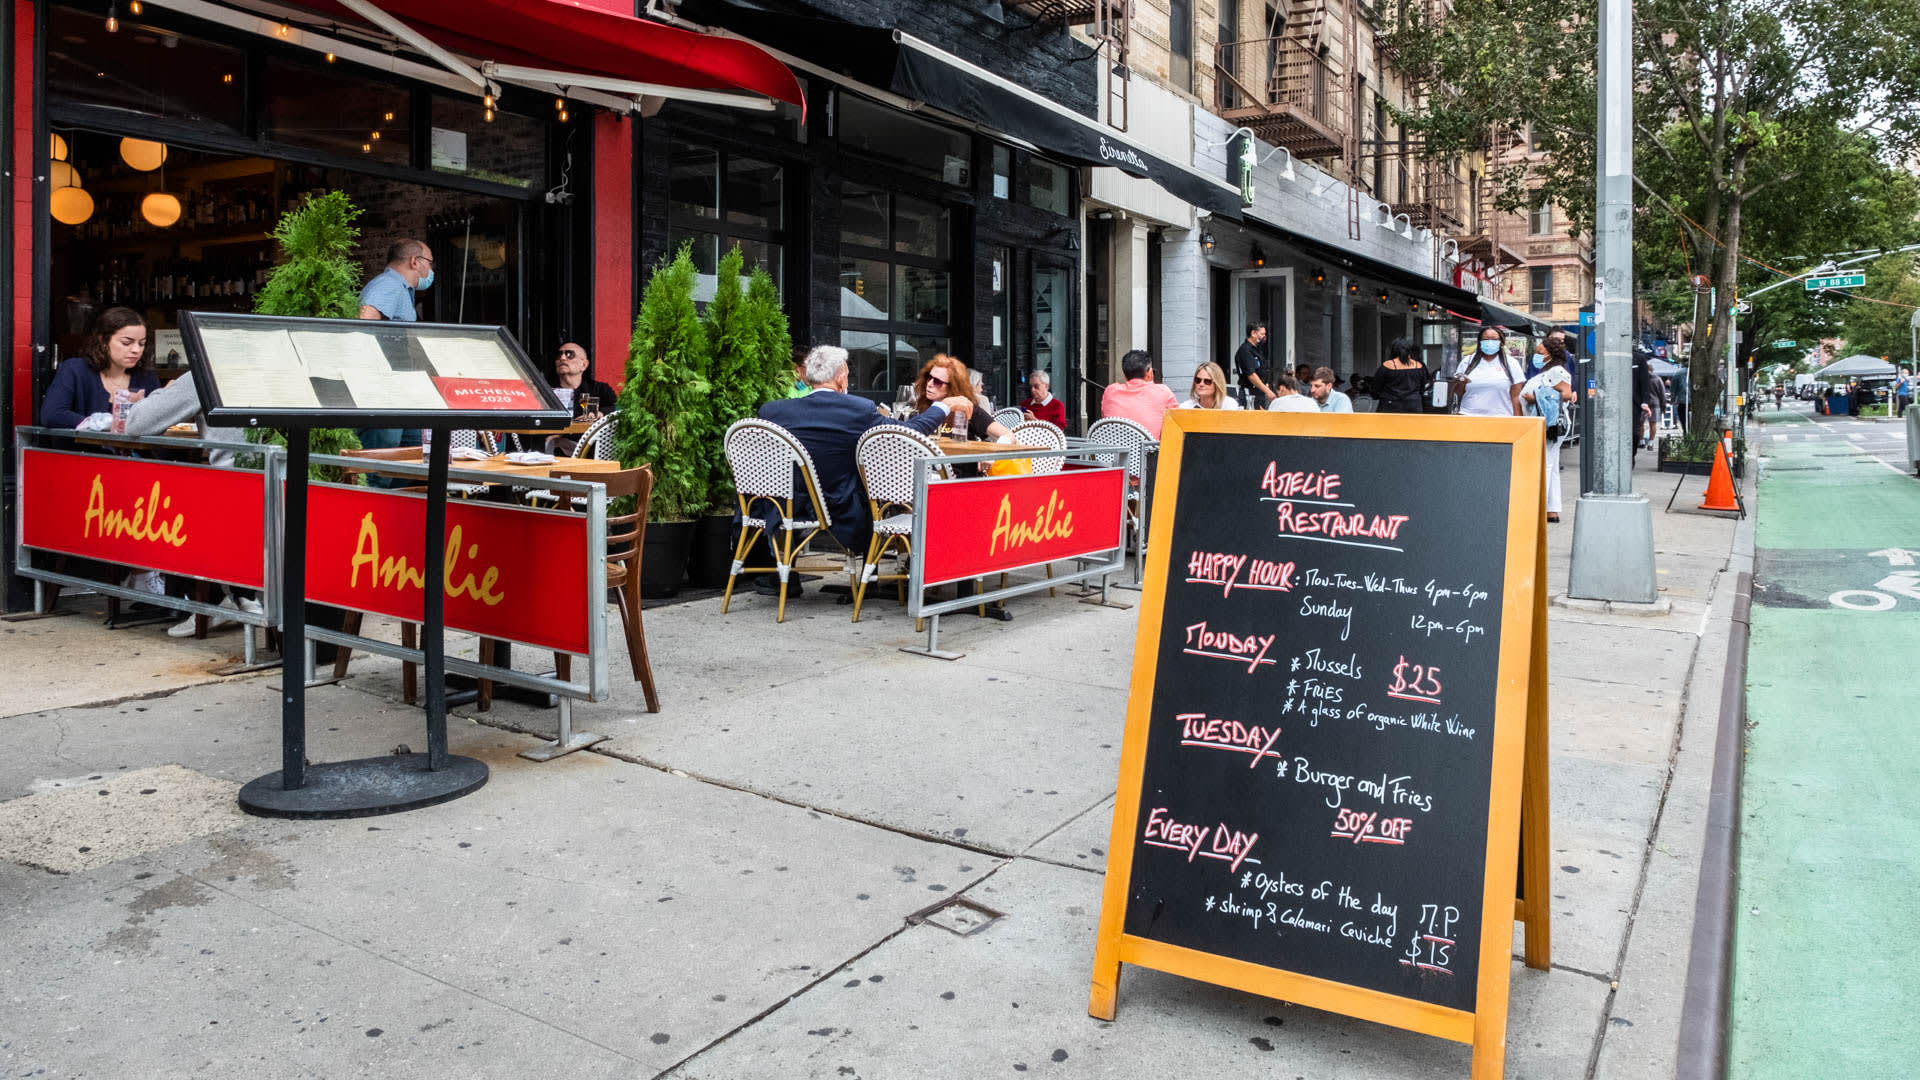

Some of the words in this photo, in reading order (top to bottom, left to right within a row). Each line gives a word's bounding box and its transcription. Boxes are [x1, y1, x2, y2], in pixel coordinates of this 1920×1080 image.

[1818, 279, 1827, 287] W
[1830, 278, 1841, 287] 88
[1843, 277, 1852, 285] St
[454, 388, 526, 397] MICHELIN
[480, 395, 512, 403] 2020
[84, 473, 187, 547] Amélie
[990, 488, 1074, 557] Amélie
[1277, 501, 1409, 540] RESTAURANT
[351, 511, 504, 605] Amlie
[1187, 550, 1247, 598] HAPPY
[1300, 596, 1352, 641] Sunday
[1186, 621, 1276, 674] MONDAY
[1305, 648, 1363, 681] Mussels
[1388, 655, 1442, 697] $25
[1176, 713, 1282, 769] TUESDAY
[1297, 701, 1308, 715] A
[1311, 700, 1341, 727] glass
[1346, 702, 1368, 720] of
[1368, 712, 1408, 731] organic
[1411, 713, 1442, 733] White
[1446, 714, 1476, 740] Wine
[1294, 757, 1355, 809] Burger
[1358, 773, 1387, 804] and
[1388, 776, 1433, 812] Fries
[1144, 807, 1210, 864] EVERY
[1212, 822, 1259, 874] DAY
[1334, 808, 1379, 844] 50%
[1380, 817, 1413, 840] OFF
[1255, 872, 1305, 900] Oysters
[1311, 880, 1333, 900] of
[1338, 886, 1364, 910] the
[1371, 892, 1398, 937] day
[1266, 902, 1277, 924] &
[1280, 908, 1332, 933] Calamari
[1340, 922, 1393, 949] Ceviche
